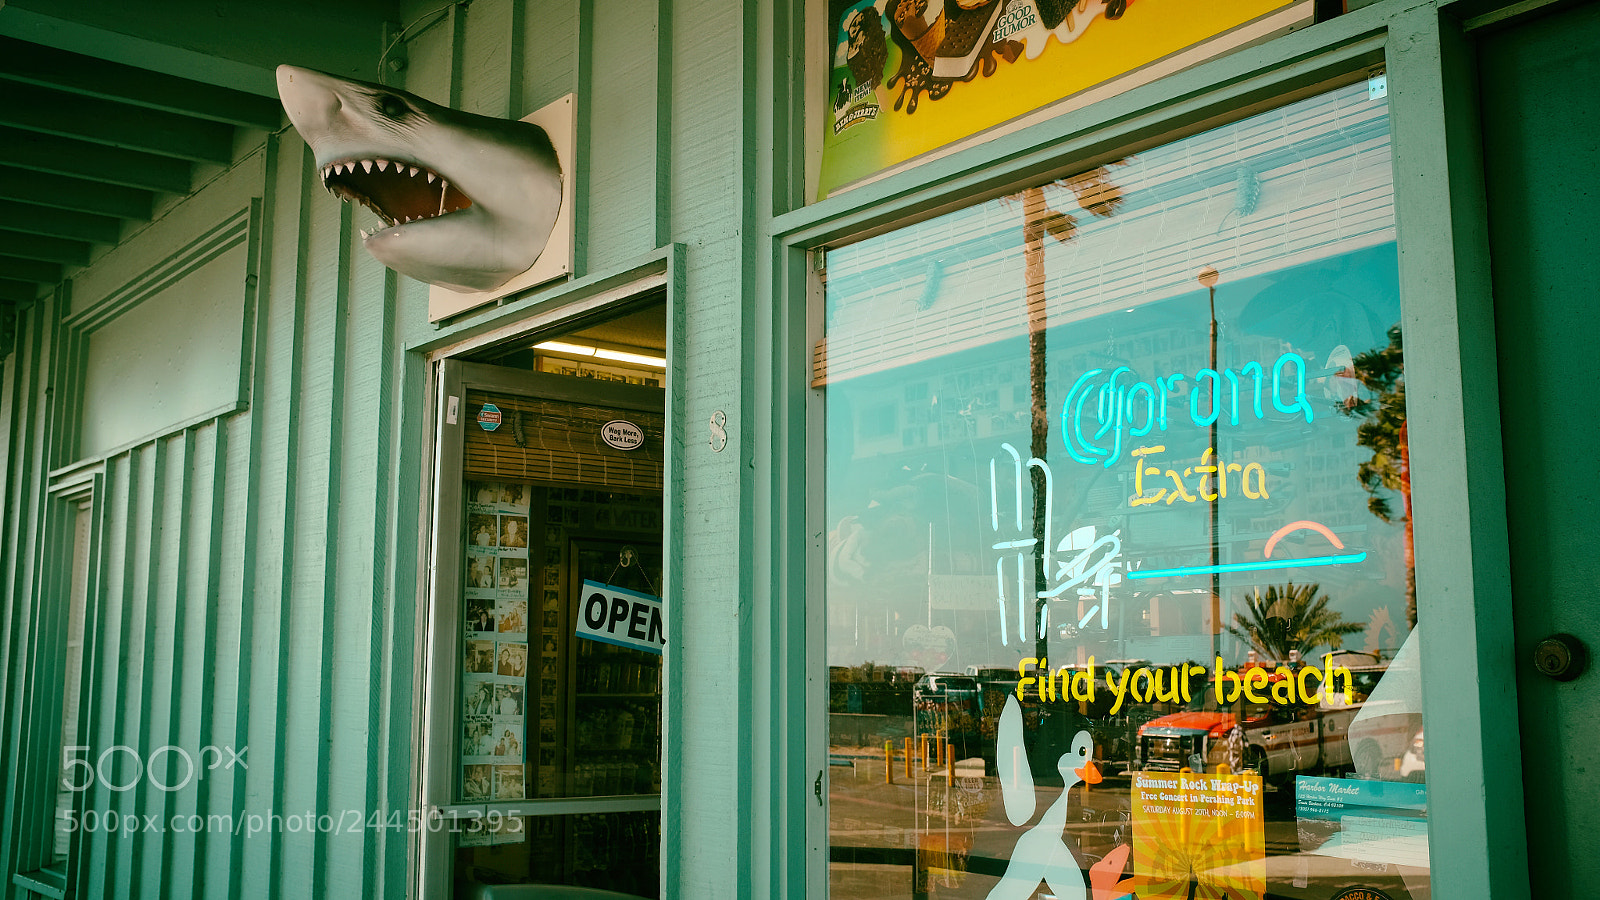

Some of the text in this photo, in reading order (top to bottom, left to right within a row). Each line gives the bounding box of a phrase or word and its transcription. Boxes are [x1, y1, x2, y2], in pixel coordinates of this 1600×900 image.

[994, 14, 1036, 41] HUMOR
[999, 5, 1031, 28] GOOD
[854, 80, 871, 96] NEW
[1060, 352, 1313, 468] Corona
[622, 429, 639, 438] More,
[709, 410, 727, 453] 8
[1131, 446, 1269, 507] Extra
[584, 592, 665, 645] OPEN
[1106, 663, 1205, 715] your
[1215, 653, 1353, 705] beach
[1136, 776, 1259, 795] Summer Rock Wrap-Up
[1298, 780, 1360, 795] Harbor Market
[1141, 791, 1255, 806] Free Concert in Pershing Park
[1142, 804, 1171, 814] SATURDAY
[1172, 807, 1194, 815] AUGUST
[1212, 809, 1228, 817] NOON
